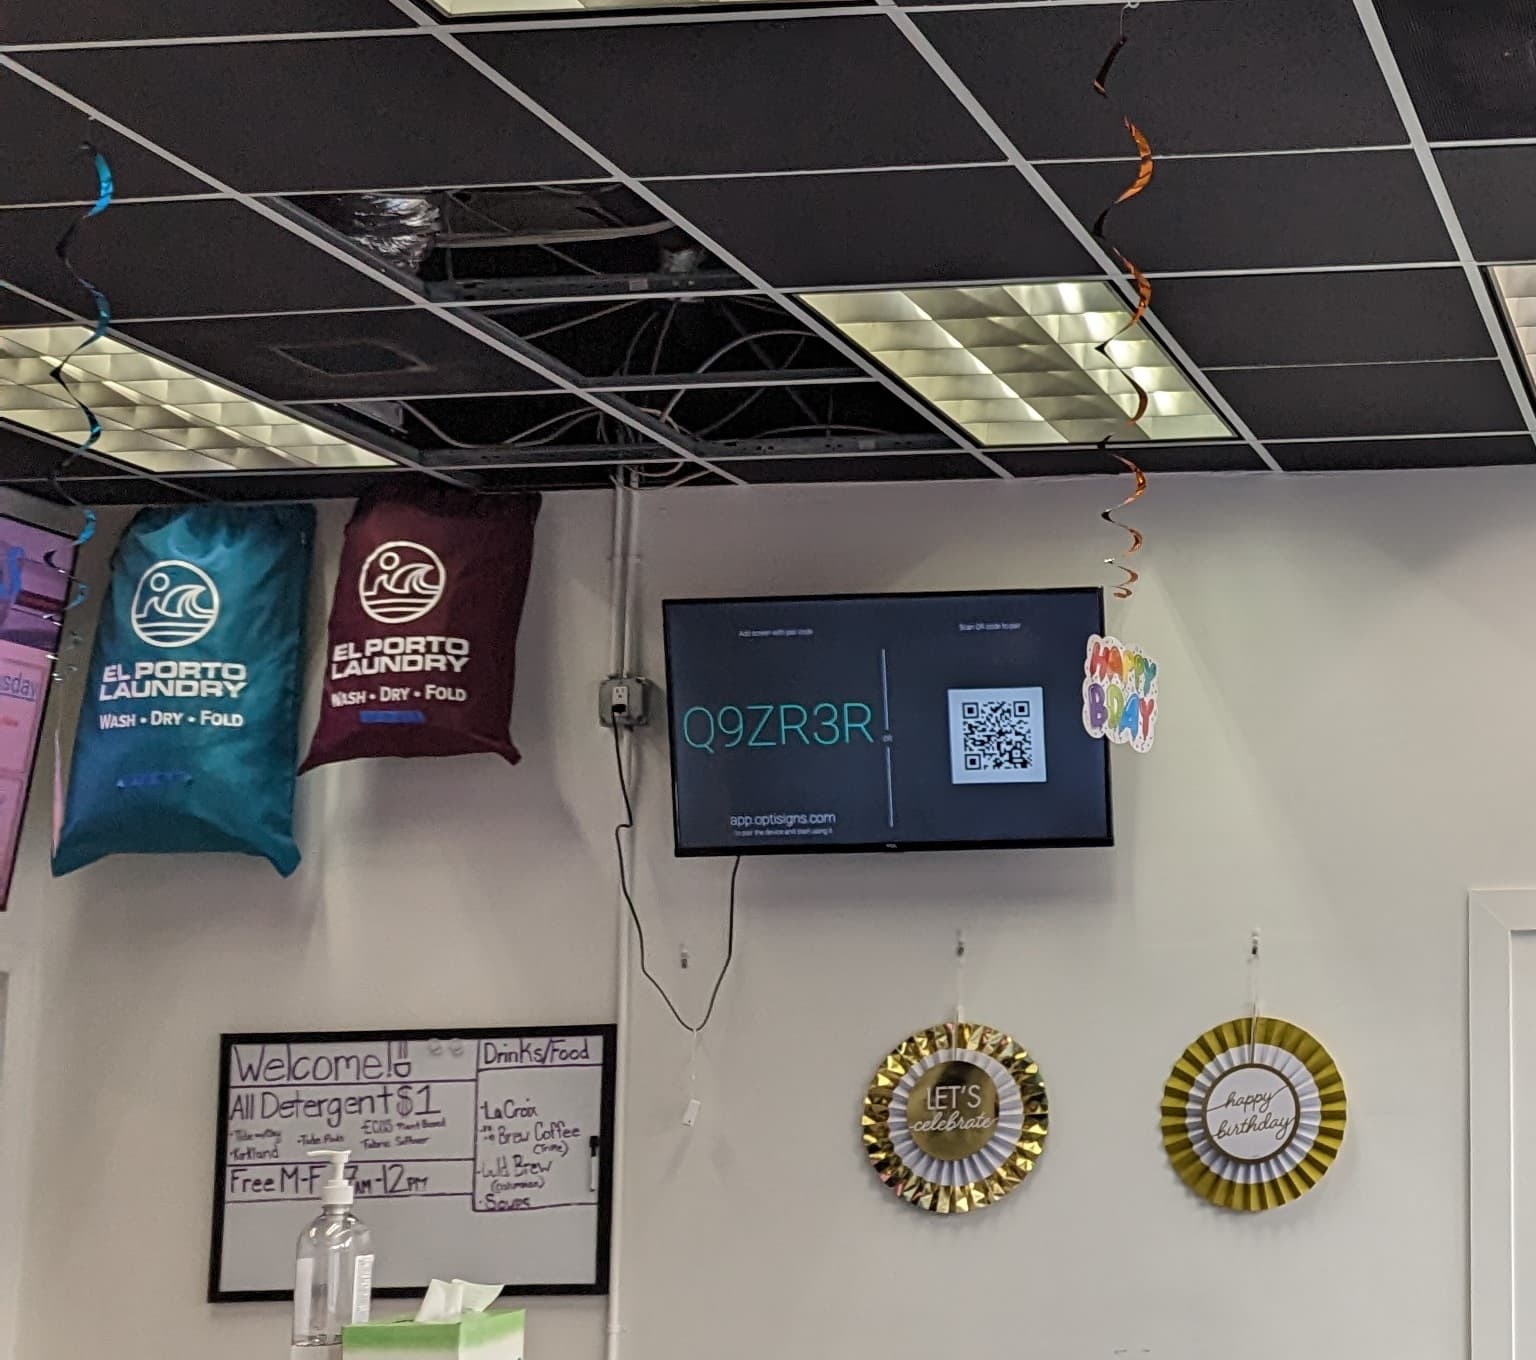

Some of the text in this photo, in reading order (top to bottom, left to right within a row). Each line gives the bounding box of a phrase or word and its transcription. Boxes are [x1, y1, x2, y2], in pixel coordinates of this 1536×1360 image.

[333, 636, 470, 661] EL PORTO
[102, 661, 247, 683] EL PORTO
[331, 654, 470, 680] LAUNDRY
[1090, 641, 1157, 697] HAPPY
[99, 679, 248, 701] LAUNDRY
[331, 684, 467, 707] WASH DRY FOLD
[100, 710, 243, 729] WASH DRY FOLD
[1088, 683, 1155, 741] BDAY
[683, 702, 874, 754] Q9ZR3R
[730, 812, 837, 828] app.optisigns.com
[229, 1085, 441, 1128] All Detergent $1
[926, 1084, 981, 1110] LET'S
[1214, 1089, 1280, 1113] happy
[534, 1120, 581, 1142] Coffee
[910, 1110, 996, 1132] celebrate
[1214, 1112, 1294, 1141] birthday
[512, 1153, 553, 1178] Brew
[230, 1168, 275, 1194] Free
[281, 1165, 328, 1195] M-F
